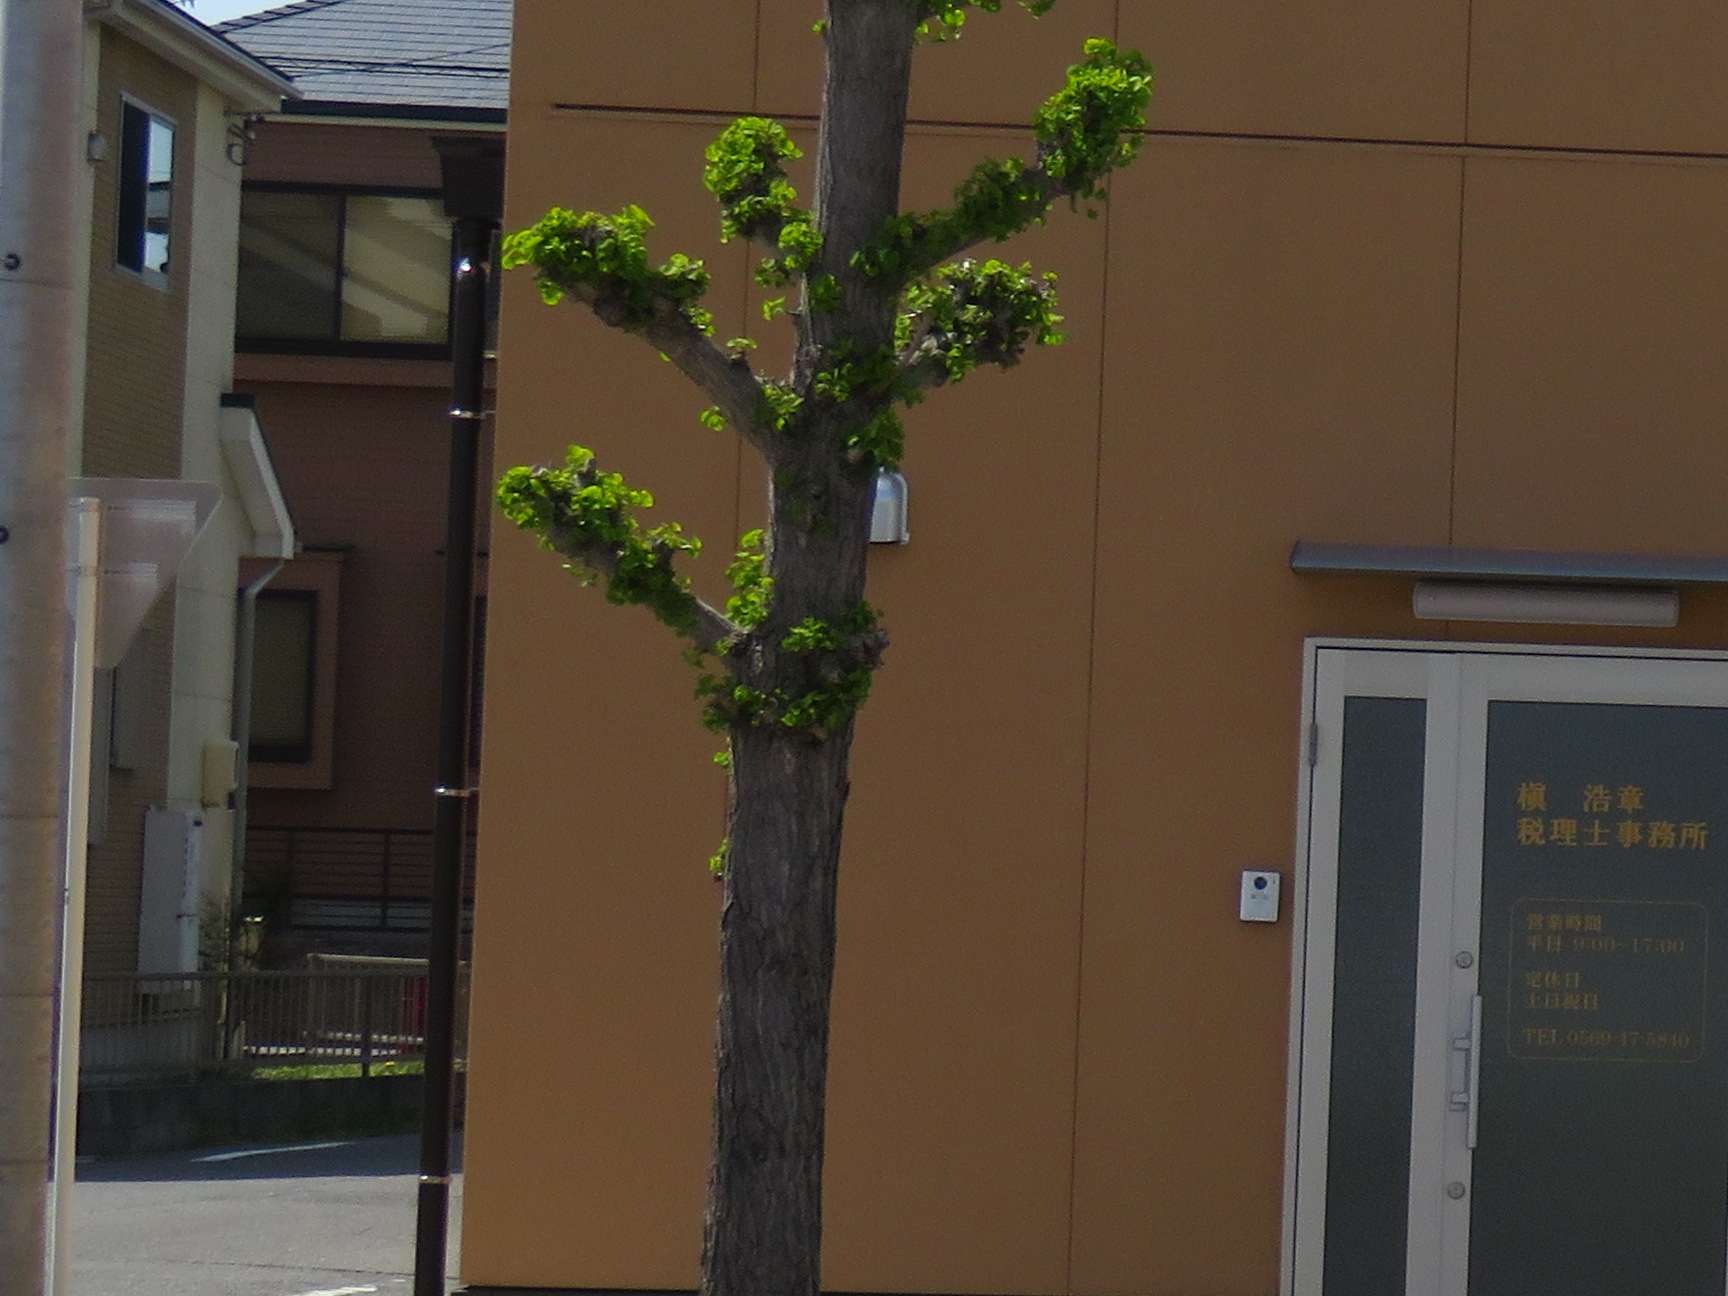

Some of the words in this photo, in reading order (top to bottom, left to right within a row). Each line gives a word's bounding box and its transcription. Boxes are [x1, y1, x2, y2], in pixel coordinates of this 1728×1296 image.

[1516, 817, 1709, 850] 税理士事務所
[1526, 913, 1602, 932] 営業時間
